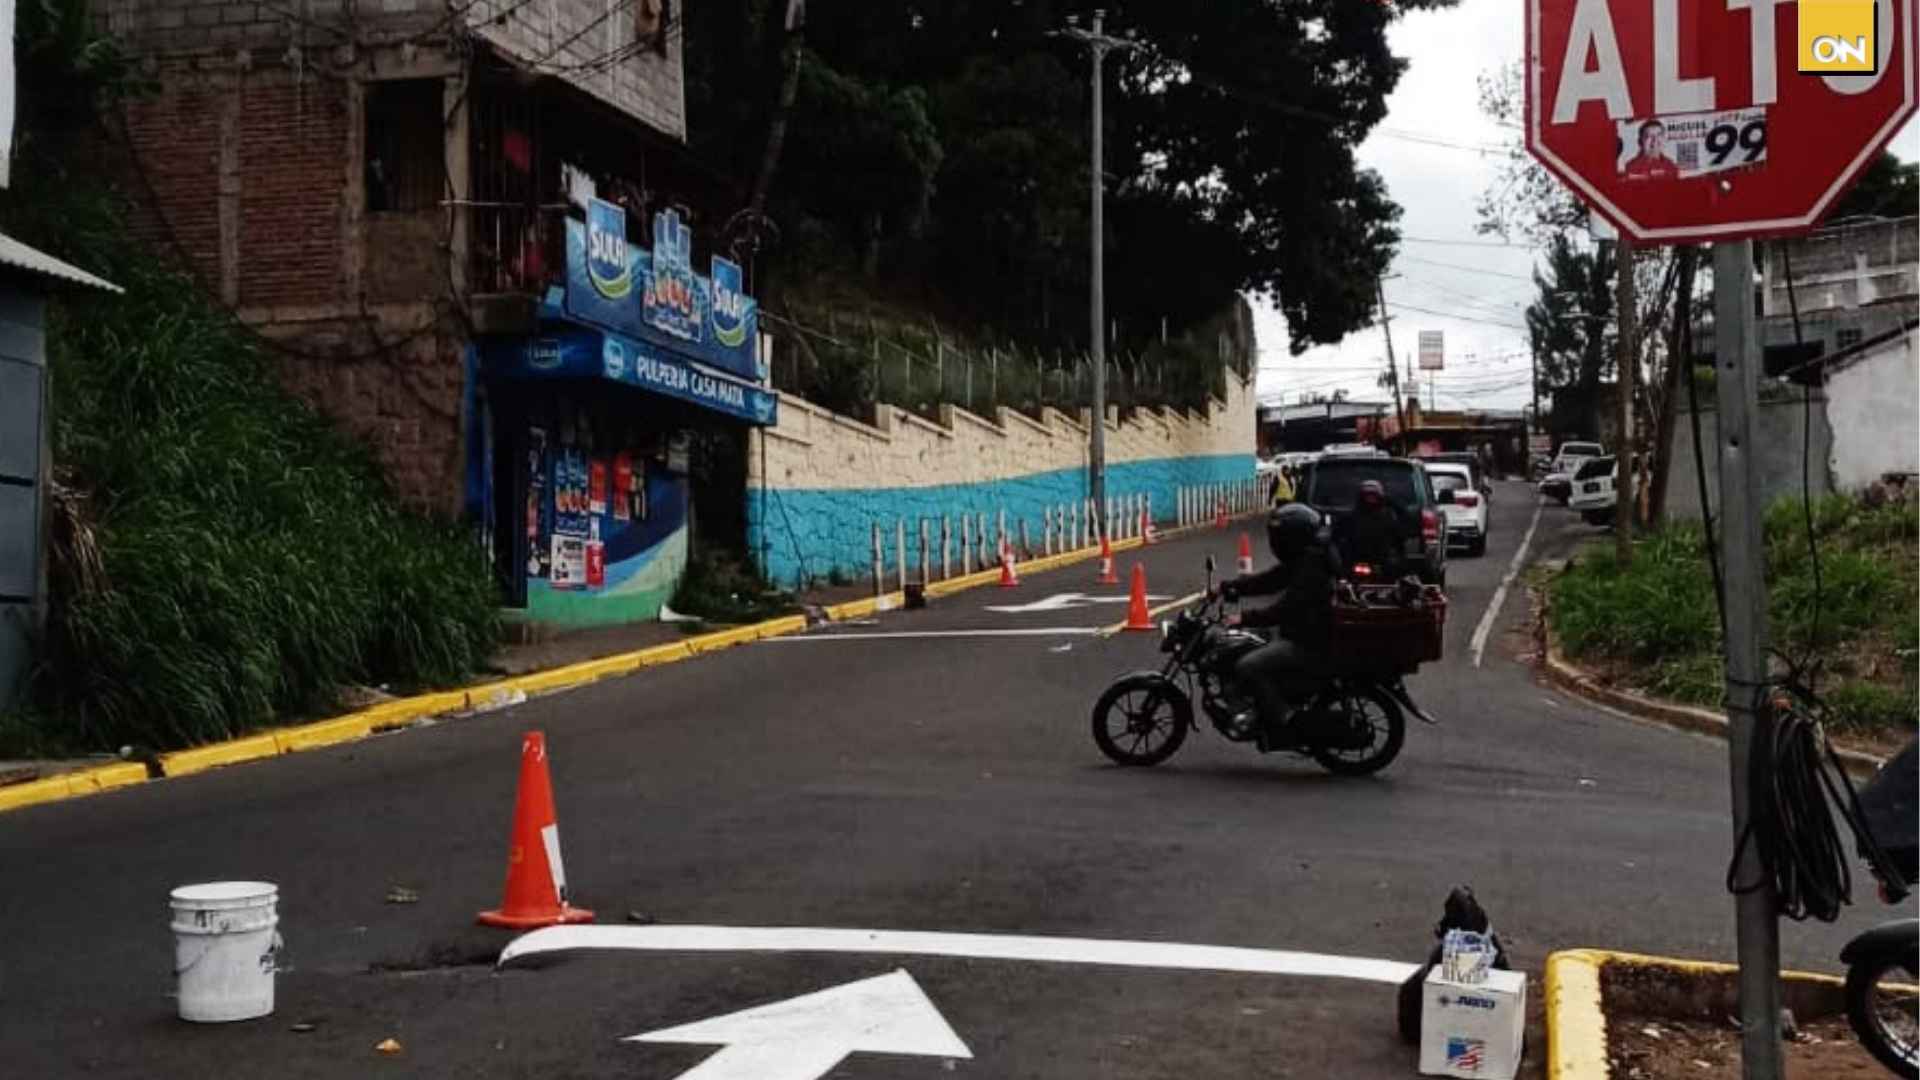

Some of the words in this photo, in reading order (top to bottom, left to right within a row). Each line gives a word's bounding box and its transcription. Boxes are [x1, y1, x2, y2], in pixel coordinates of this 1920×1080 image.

[1704, 120, 1766, 166] 99
[591, 229, 624, 268] SULA
[713, 282, 739, 318] SULA
[636, 355, 688, 390] PULPERIA
[691, 372, 716, 398] CASA
